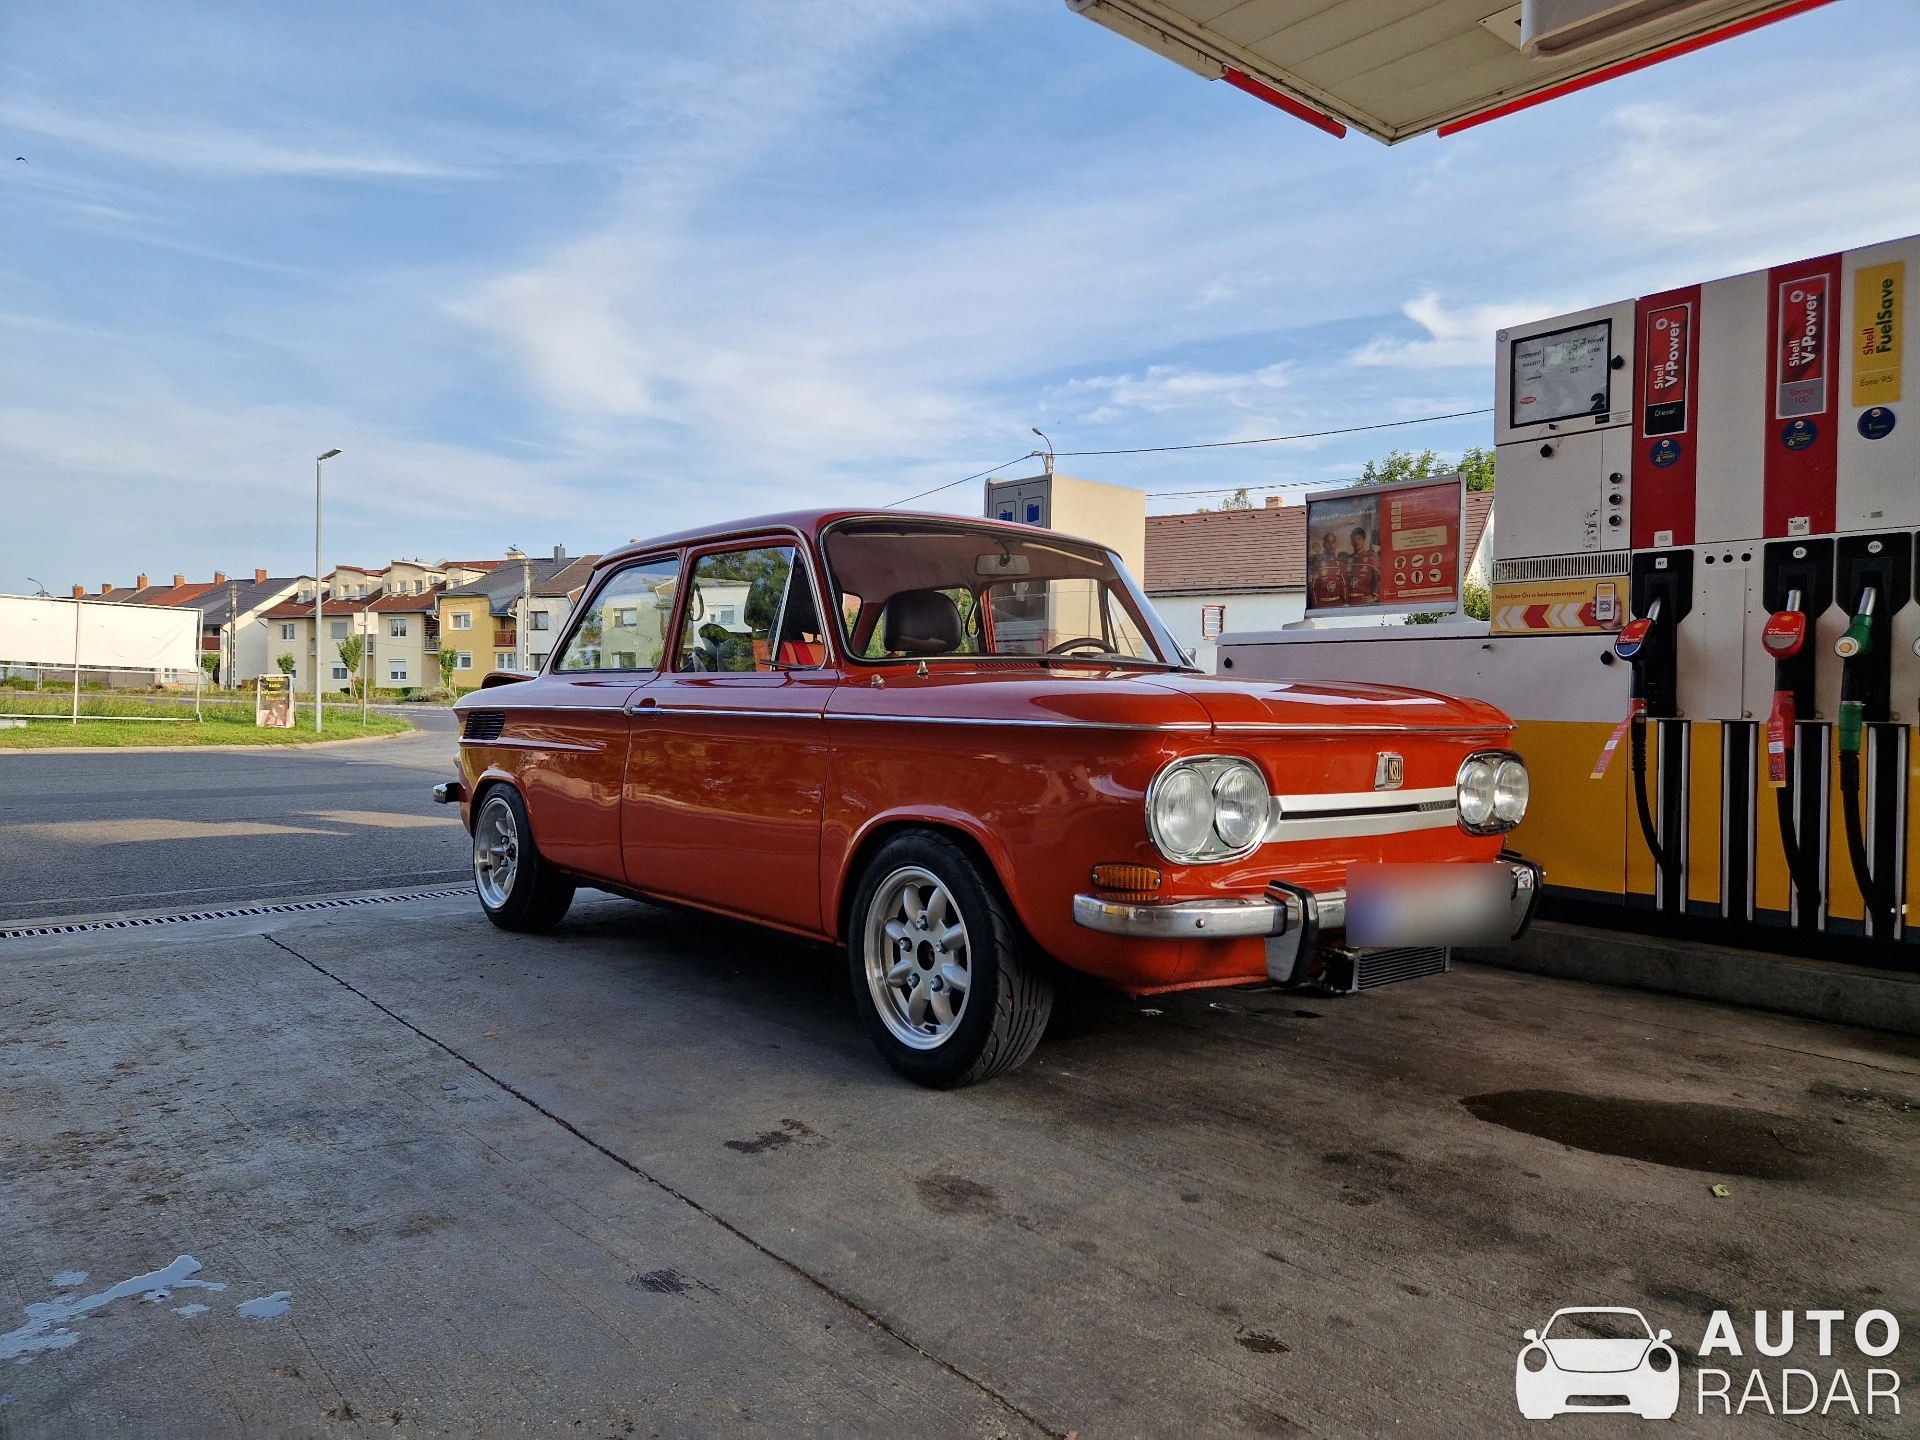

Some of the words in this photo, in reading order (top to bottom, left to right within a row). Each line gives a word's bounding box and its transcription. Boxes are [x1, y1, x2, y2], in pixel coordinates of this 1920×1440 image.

[1875, 278, 1894, 354] FuelSave
[1800, 293, 1818, 365] V-Power
[1863, 327, 1874, 356] Shell
[1665, 321, 1680, 388] V-Power
[1789, 340, 1800, 367] Shell
[1654, 365, 1664, 390] Shell
[1859, 377, 1878, 387] Euro
[1880, 374, 1893, 384] 95
[1591, 392, 1605, 411] 2
[1789, 387, 1815, 398] Racing
[1654, 408, 1677, 418] Diesel
[1522, 591, 1531, 599] Ön
[1389, 760, 1400, 780] NSU
